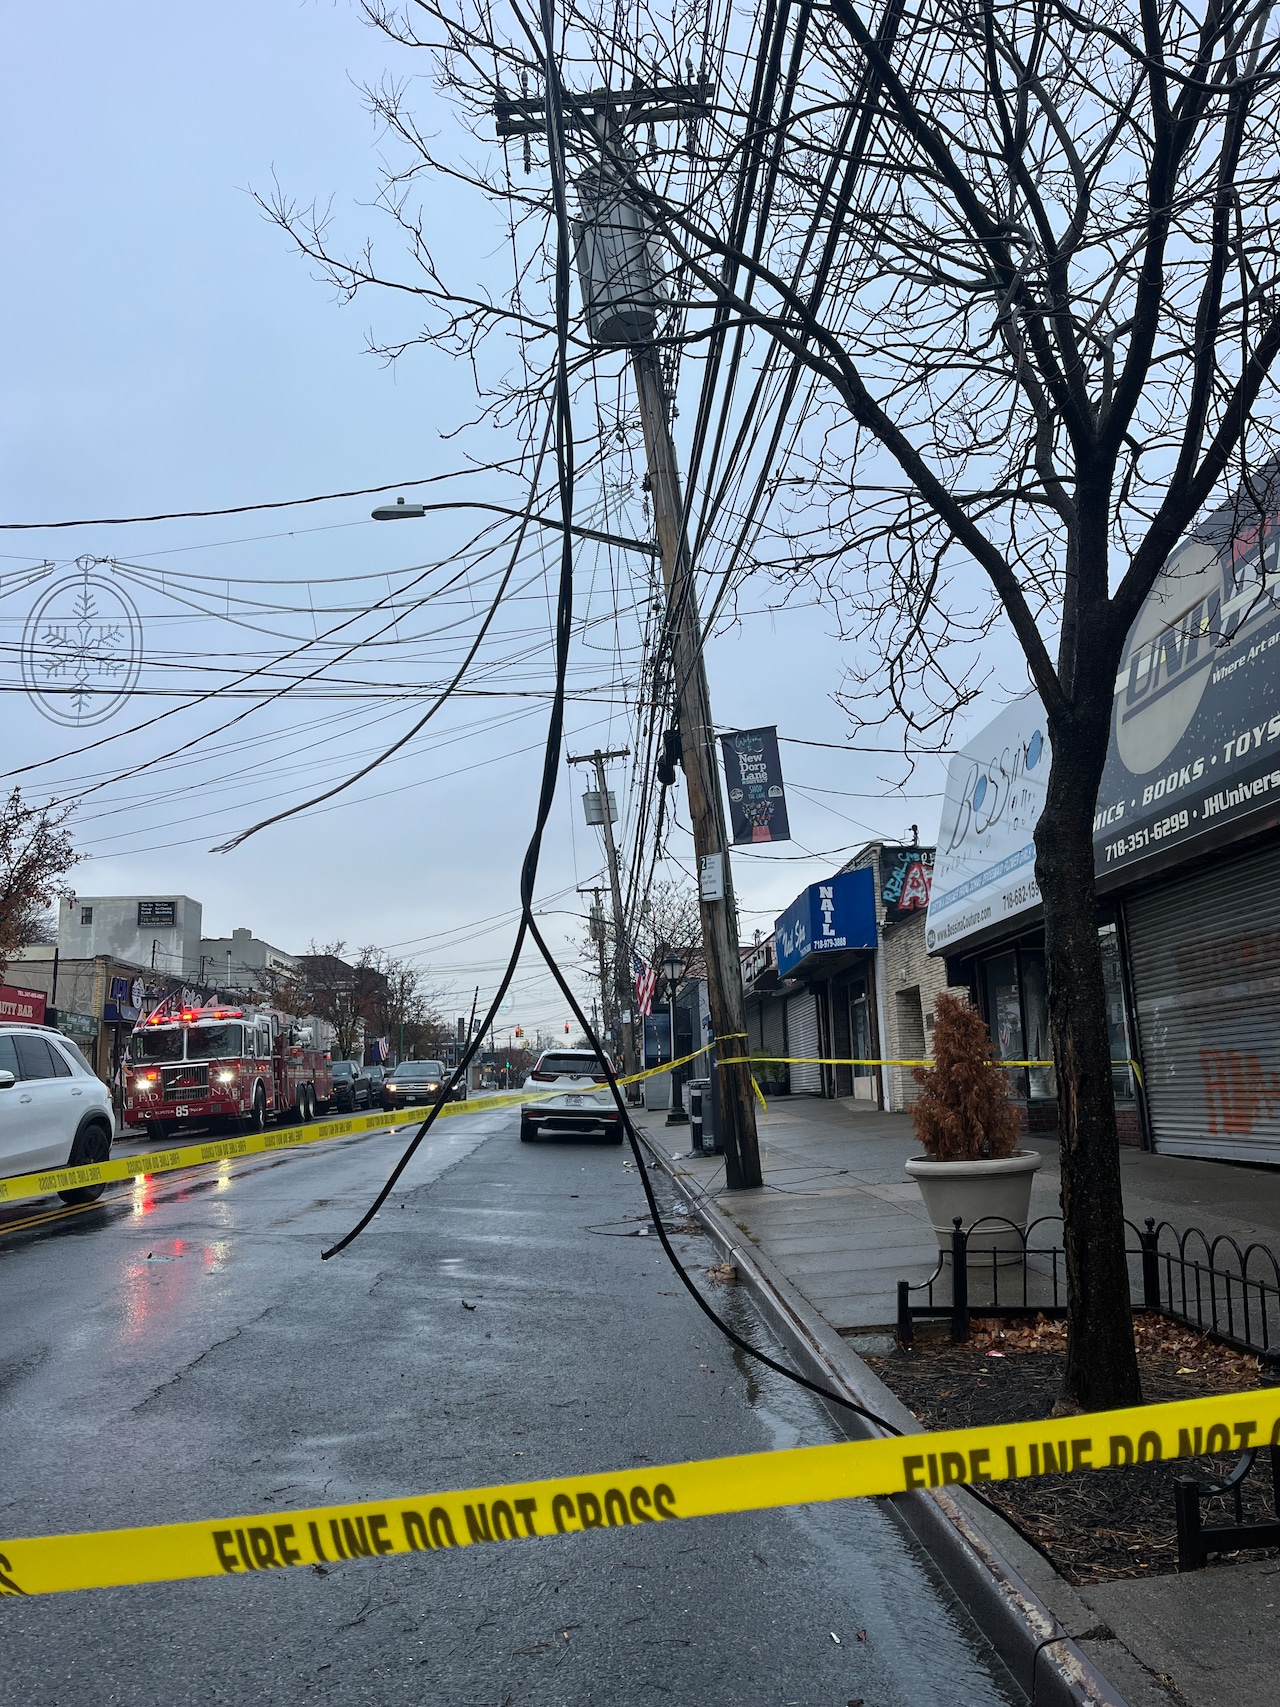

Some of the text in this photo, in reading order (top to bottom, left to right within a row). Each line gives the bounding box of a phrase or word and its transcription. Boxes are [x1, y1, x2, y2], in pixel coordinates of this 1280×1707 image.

[1212, 656, 1246, 684] Where
[1245, 639, 1267, 664] Art
[735, 733, 762, 748] Welcome
[738, 753, 763, 764] New
[1141, 757, 1205, 807] BOOKS
[1223, 714, 1280, 764] TOYS
[739, 762, 767, 773] Dorp
[741, 771, 768, 781] Lane
[748, 785, 763, 793] SHOP
[1105, 809, 1189, 862] 718-351-6299
[701, 857, 706, 869] 2
[882, 861, 908, 902] REAL
[819, 886, 836, 937] NAIL
[17, 1004, 33, 1018] BAR
[138, 1092, 161, 1103] F.D.
[175, 1104, 189, 1117] 85
[902, 1448, 991, 1490] FIRE
[1005, 1438, 1093, 1479] LINE
[1108, 1430, 1162, 1467] DO
[1178, 1420, 1257, 1458] NOT
[212, 1483, 680, 1574] FIRE LINE DO NOT CROSS
